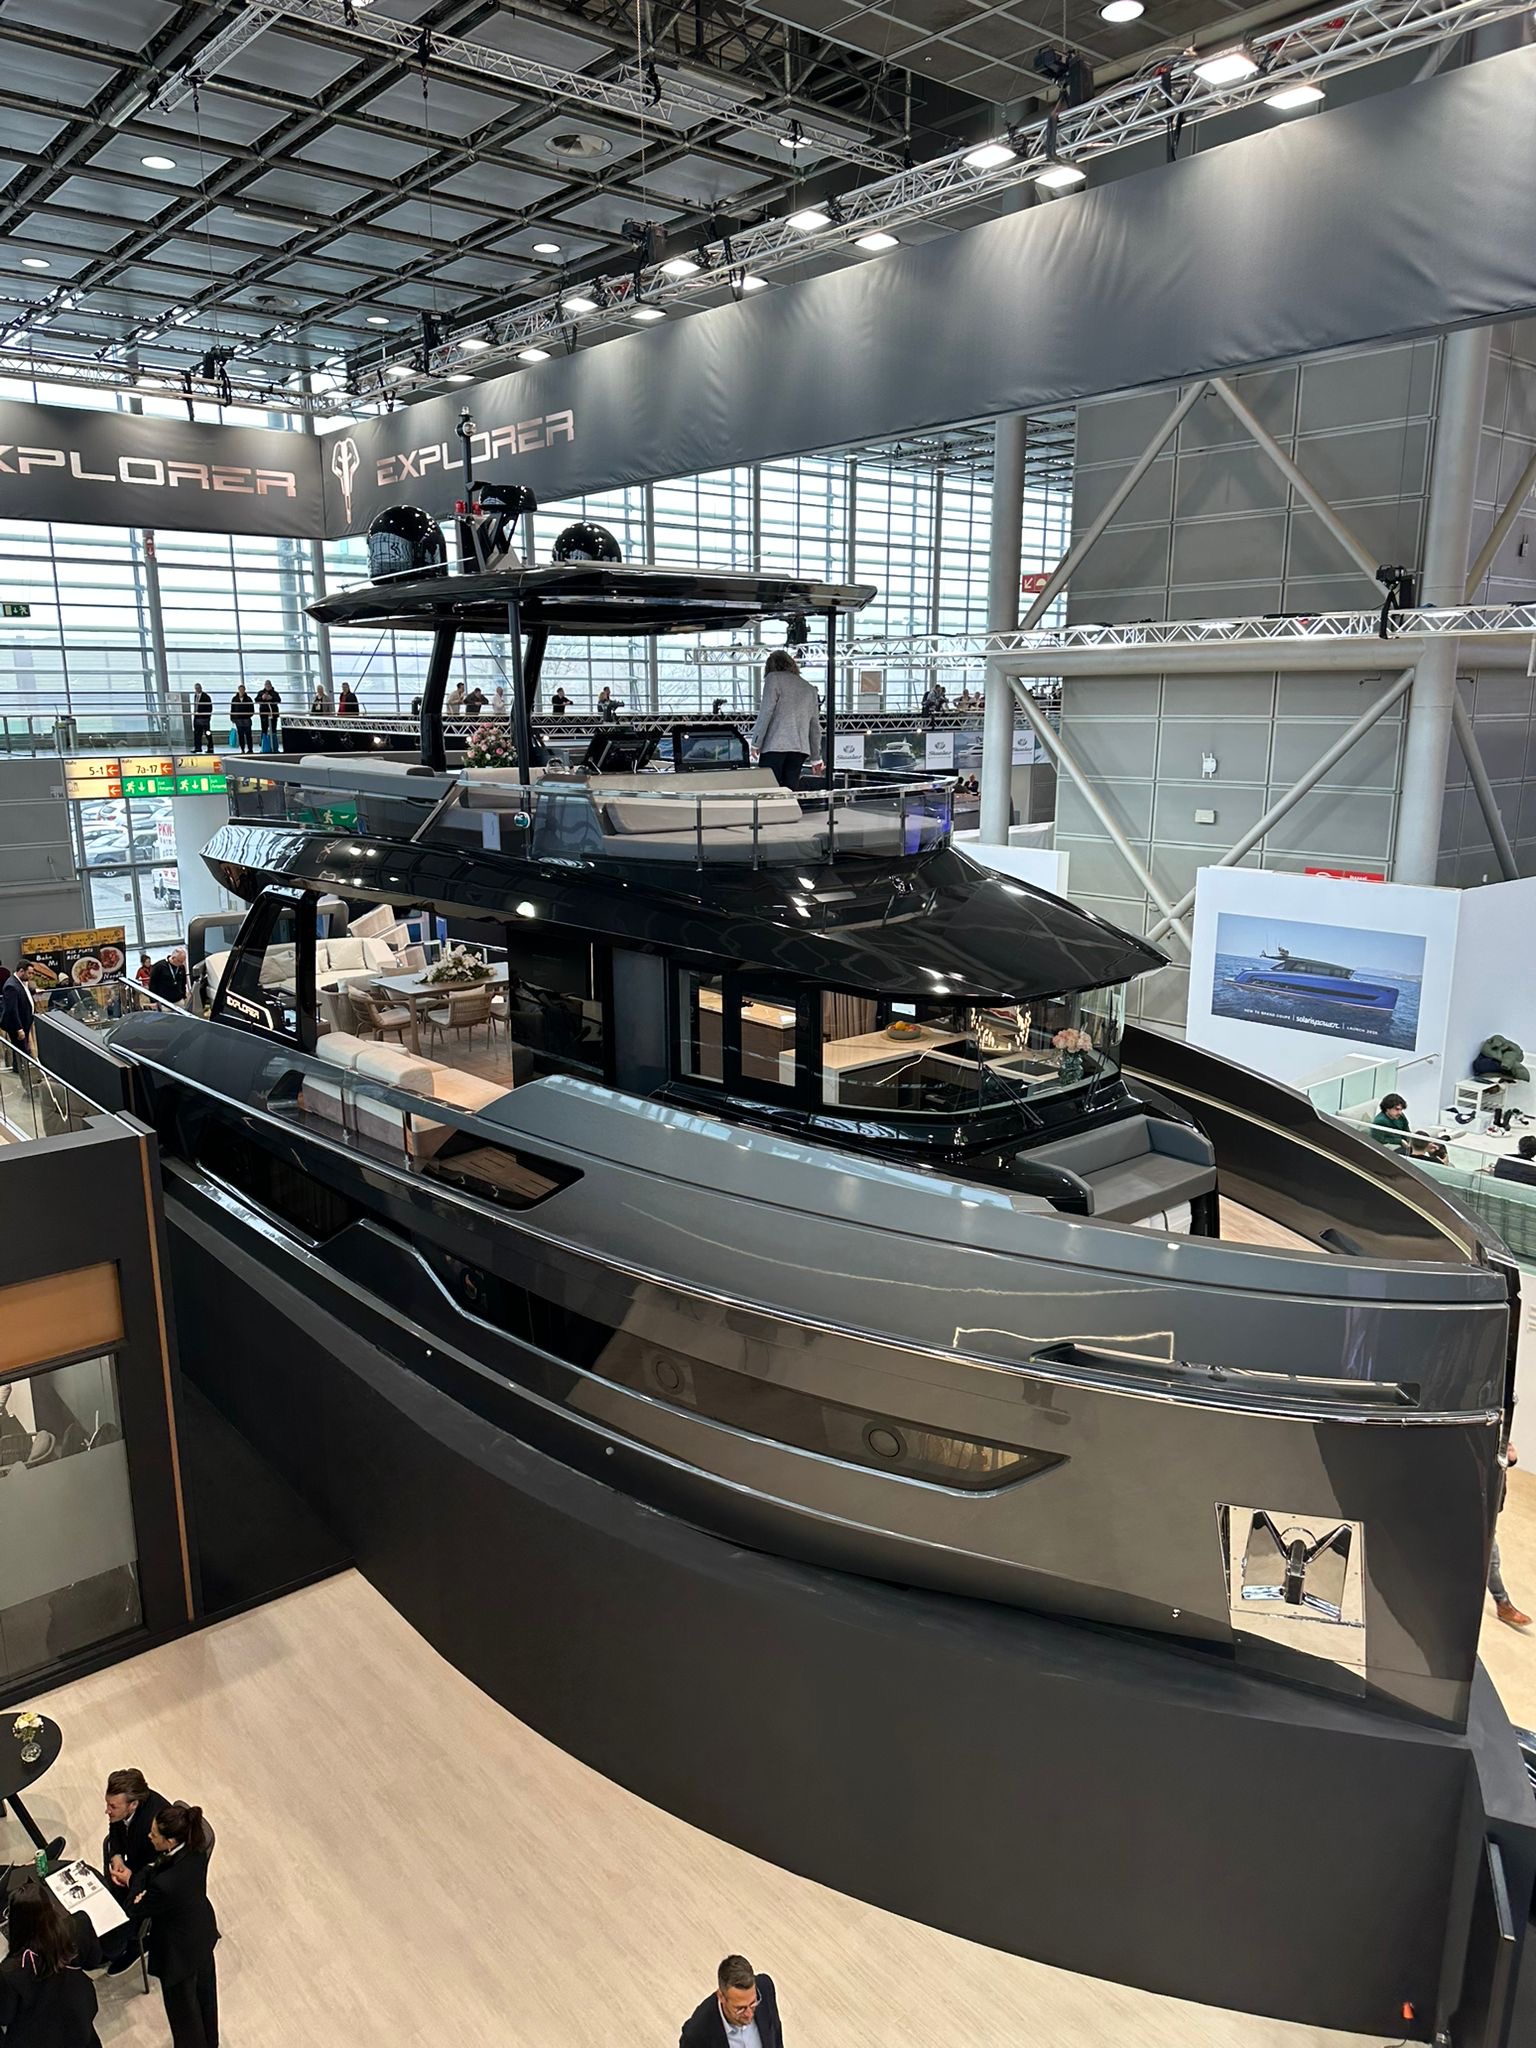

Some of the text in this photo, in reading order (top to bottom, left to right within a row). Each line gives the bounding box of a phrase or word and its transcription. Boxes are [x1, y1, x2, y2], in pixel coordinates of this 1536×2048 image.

[376, 409, 575, 487] EXPLORER
[88, 766, 104, 776] 5-1
[136, 764, 158, 774] 7a-17
